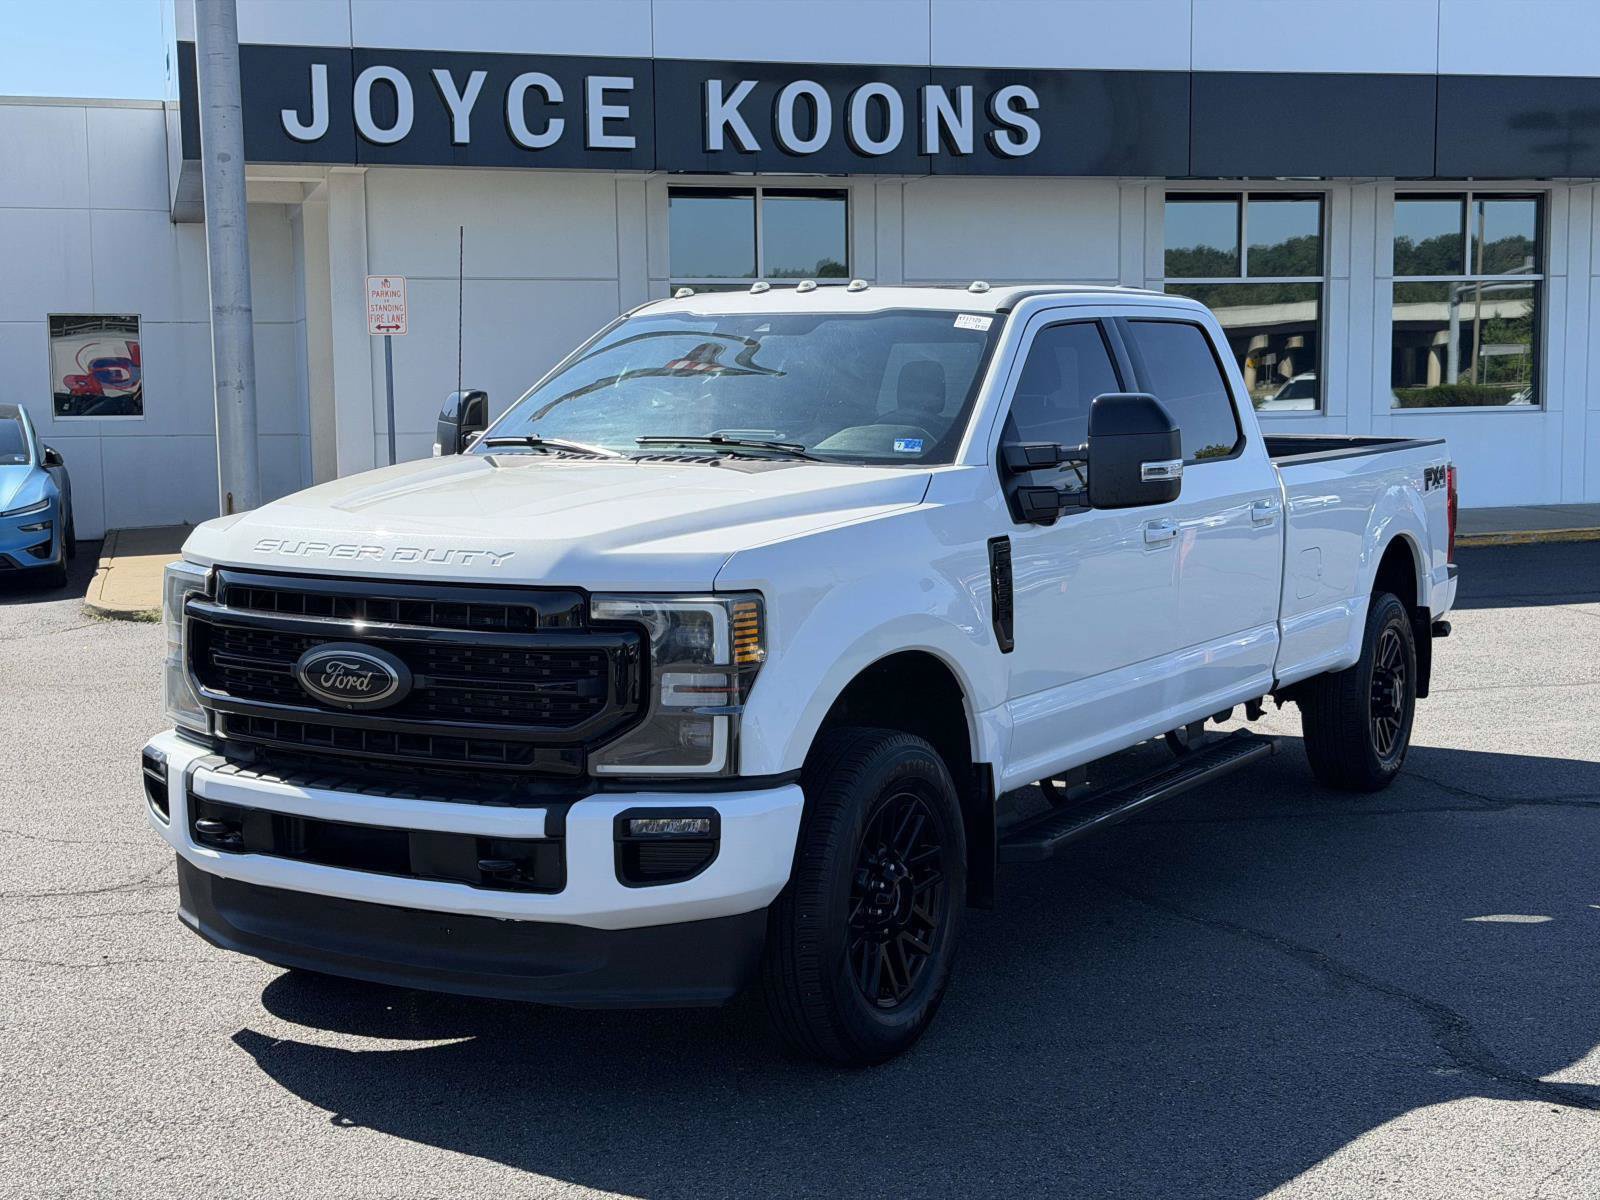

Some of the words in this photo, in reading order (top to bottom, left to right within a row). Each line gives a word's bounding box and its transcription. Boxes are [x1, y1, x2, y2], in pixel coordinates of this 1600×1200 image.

[281, 63, 636, 149] JOYCE
[703, 79, 1041, 156] KOONS
[381, 280, 391, 289] NO
[371, 290, 401, 298] PARKING
[370, 304, 404, 312] STANDING
[370, 314, 384, 323] FIRE
[387, 314, 405, 324] LANE
[1424, 464, 1446, 491] FX4
[252, 539, 386, 562] SUPER
[391, 547, 516, 568] DUTY
[320, 660, 373, 691] Ford
